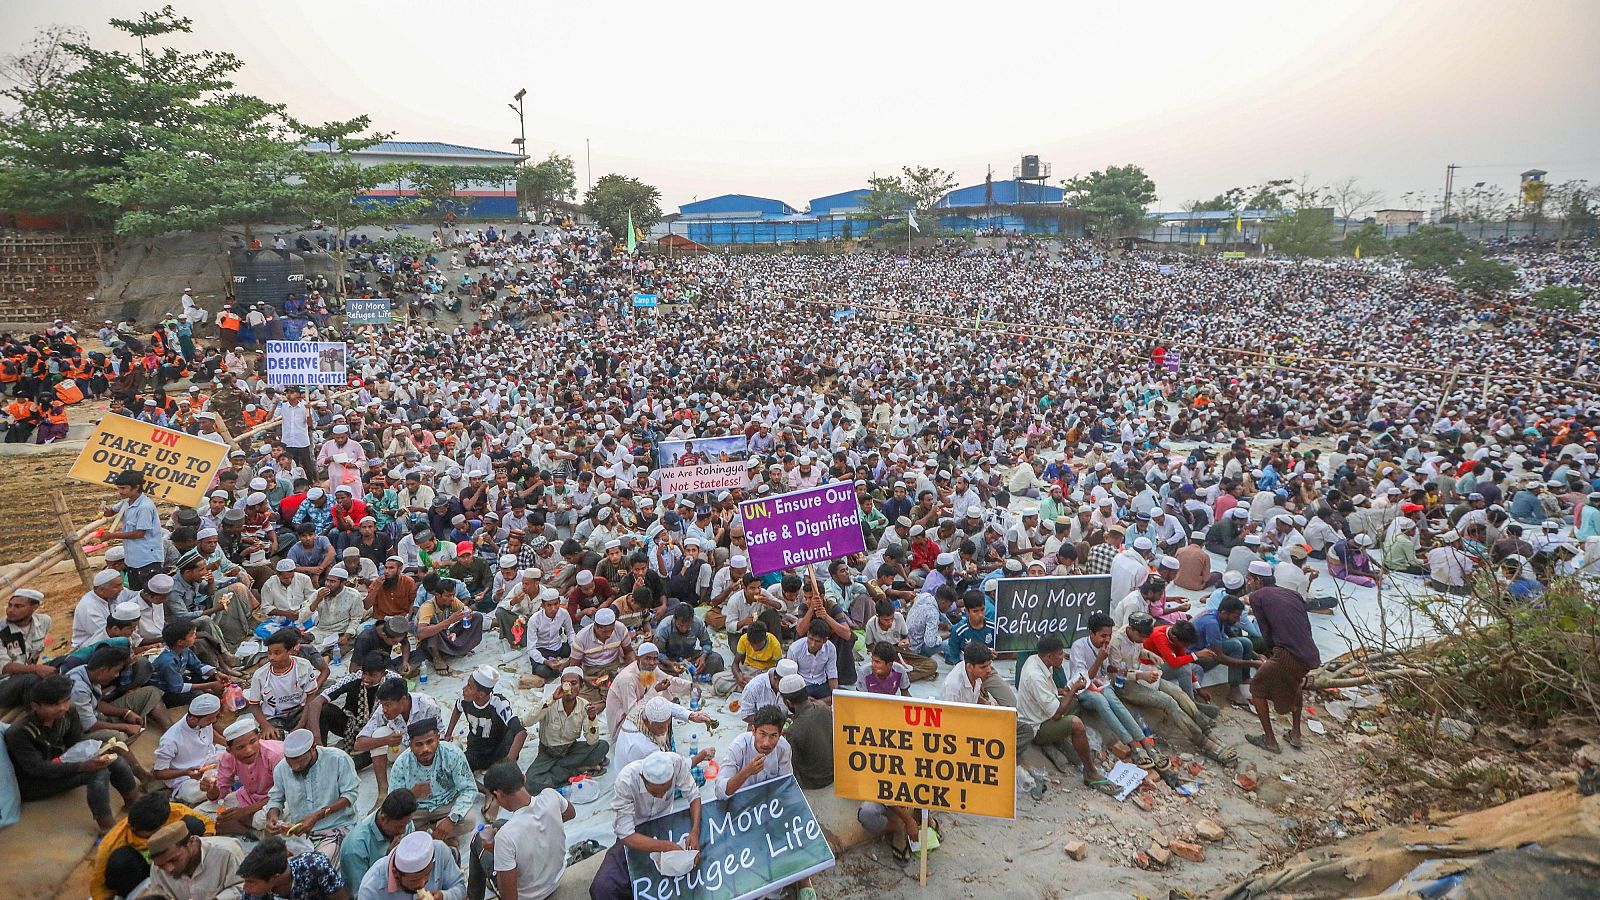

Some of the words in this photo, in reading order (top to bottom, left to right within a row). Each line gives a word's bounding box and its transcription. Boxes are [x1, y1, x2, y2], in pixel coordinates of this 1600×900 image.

[635, 297, 649, 305] Camp
[347, 311, 376, 320] Refugee
[379, 310, 392, 318] Life
[267, 343, 318, 353] ROHINGYA
[268, 357, 318, 369] DESERVE
[269, 374, 304, 384] HUMAN
[308, 374, 345, 383] RIGHTS!
[151, 428, 180, 448] UN
[99, 432, 152, 458] TAKE
[156, 448, 182, 465] US
[186, 456, 211, 473] TO
[92, 449, 137, 470] OUR
[143, 462, 200, 488] HOME
[678, 470, 692, 478] Are
[696, 464, 746, 476] Rohingya,
[103, 470, 160, 496] BK
[670, 483, 689, 492] Not
[694, 477, 741, 490] Stateless!
[744, 502, 771, 520] UN,
[775, 496, 822, 514] Ensure
[826, 489, 852, 504] Our
[746, 528, 777, 546] Safe
[782, 525, 792, 539] &
[796, 510, 858, 536] Dignified
[783, 541, 832, 566] Return!
[1012, 589, 1039, 609] No
[1047, 588, 1096, 608] More
[996, 612, 1068, 638] Refugee
[903, 705, 942, 728] UN
[843, 725, 913, 751] TAKE
[922, 732, 957, 754] US
[967, 736, 1005, 760] TO
[849, 751, 906, 776] OUR
[914, 757, 998, 786] HOME
[878, 780, 950, 808] BACK
[960, 789, 967, 810] !
[709, 798, 783, 844] More
[632, 848, 755, 900] Refugee
[766, 815, 820, 858] Life
